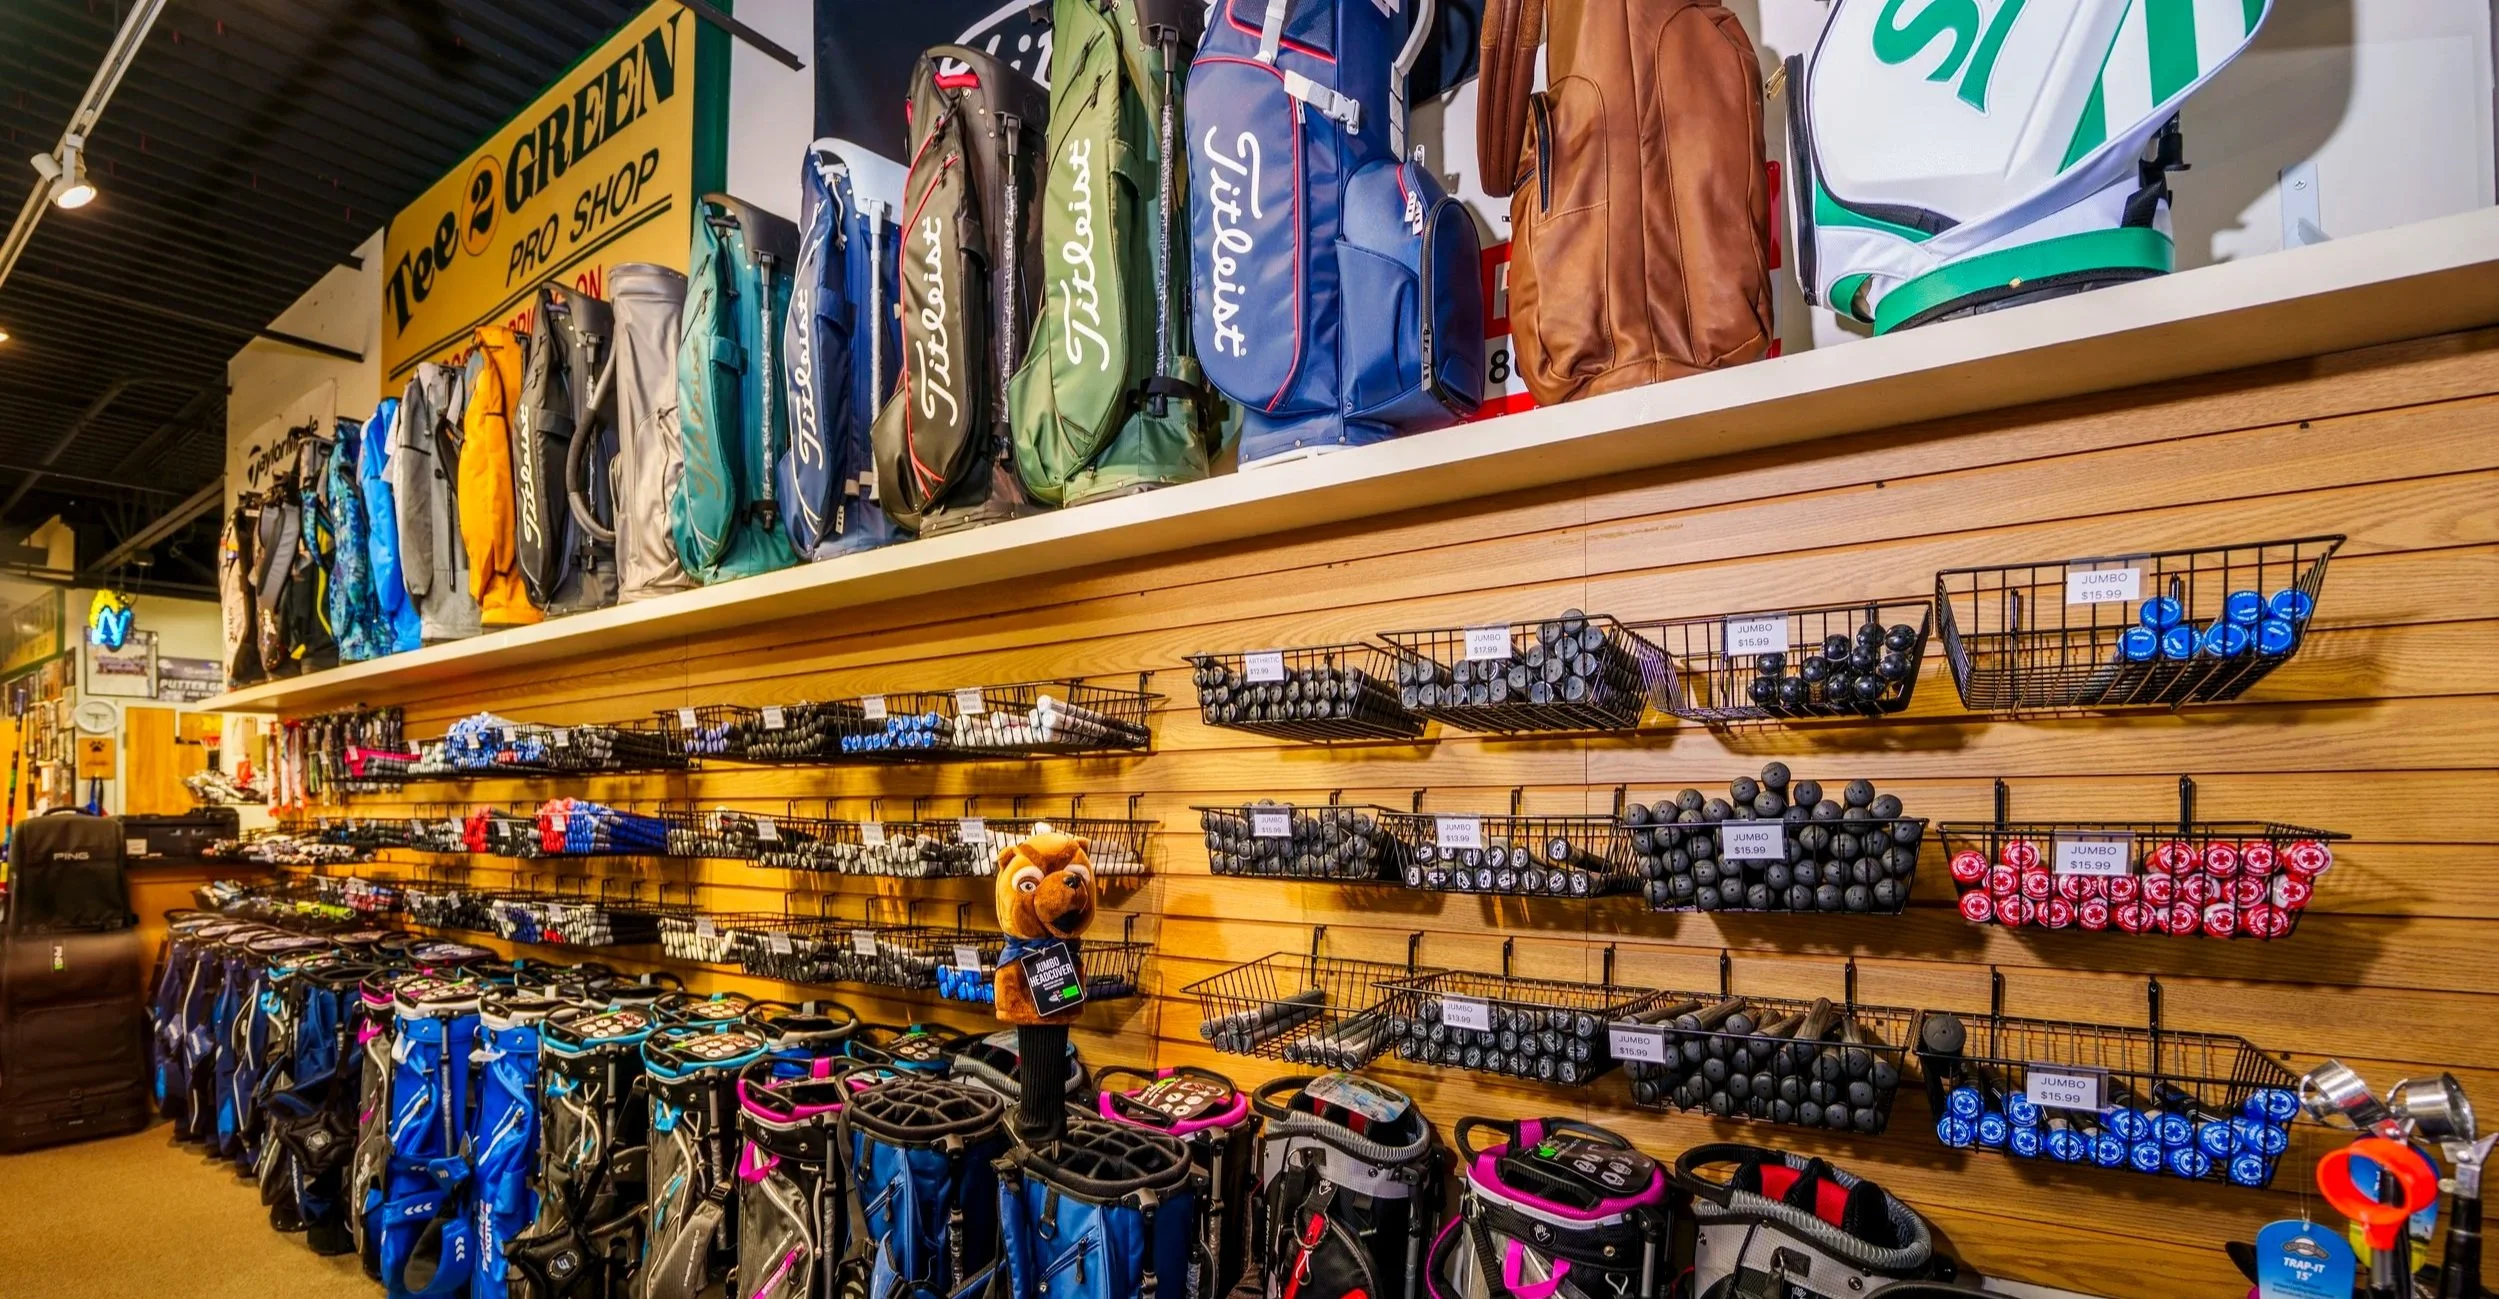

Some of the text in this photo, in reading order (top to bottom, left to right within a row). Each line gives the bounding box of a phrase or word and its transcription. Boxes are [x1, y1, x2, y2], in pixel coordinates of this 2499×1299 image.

[386, 7, 686, 338] Tee 2 GREEN
[506, 148, 660, 288] PRO SHOP
[1204, 125, 1263, 358] Titleist
[1059, 138, 1111, 371] Titleist
[921, 216, 958, 427] Titleist
[795, 289, 823, 470] Titleist
[520, 404, 542, 549] Titleist
[2081, 572, 2128, 585] JUMBO
[2081, 588, 2122, 601] $15.99
[1737, 623, 1773, 634] JUMBO
[1473, 633, 1501, 642] JUMBO
[1738, 637, 1770, 648] $15.99
[1474, 646, 1498, 654] $17.99
[1248, 656, 1280, 666] ARTHRITIC
[1261, 816, 1283, 824] JUMBO
[1261, 826, 1282, 834] $15.99
[1444, 823, 1471, 832] JUMBO
[1446, 835, 1470, 843] $13.99
[1733, 832, 1769, 842] JUMBO
[1734, 845, 1766, 855] $15.99
[2071, 846, 2117, 855] JUMBO
[53, 851, 90, 860] PING
[2070, 860, 2111, 870] $15.99
[1035, 956, 1060, 974] JUMBO
[1029, 963, 1073, 988] HEADCOVER
[1447, 1003, 1473, 1013] JUMBO
[1447, 1015, 1471, 1024] $13.99
[1618, 1035, 1651, 1045] JUMBO
[1619, 1047, 1648, 1057] $15.99
[2040, 1076, 2086, 1089] JUMBO
[2040, 1091, 2081, 1104] $15.99
[2283, 1257, 2326, 1273] TRAP-IT
